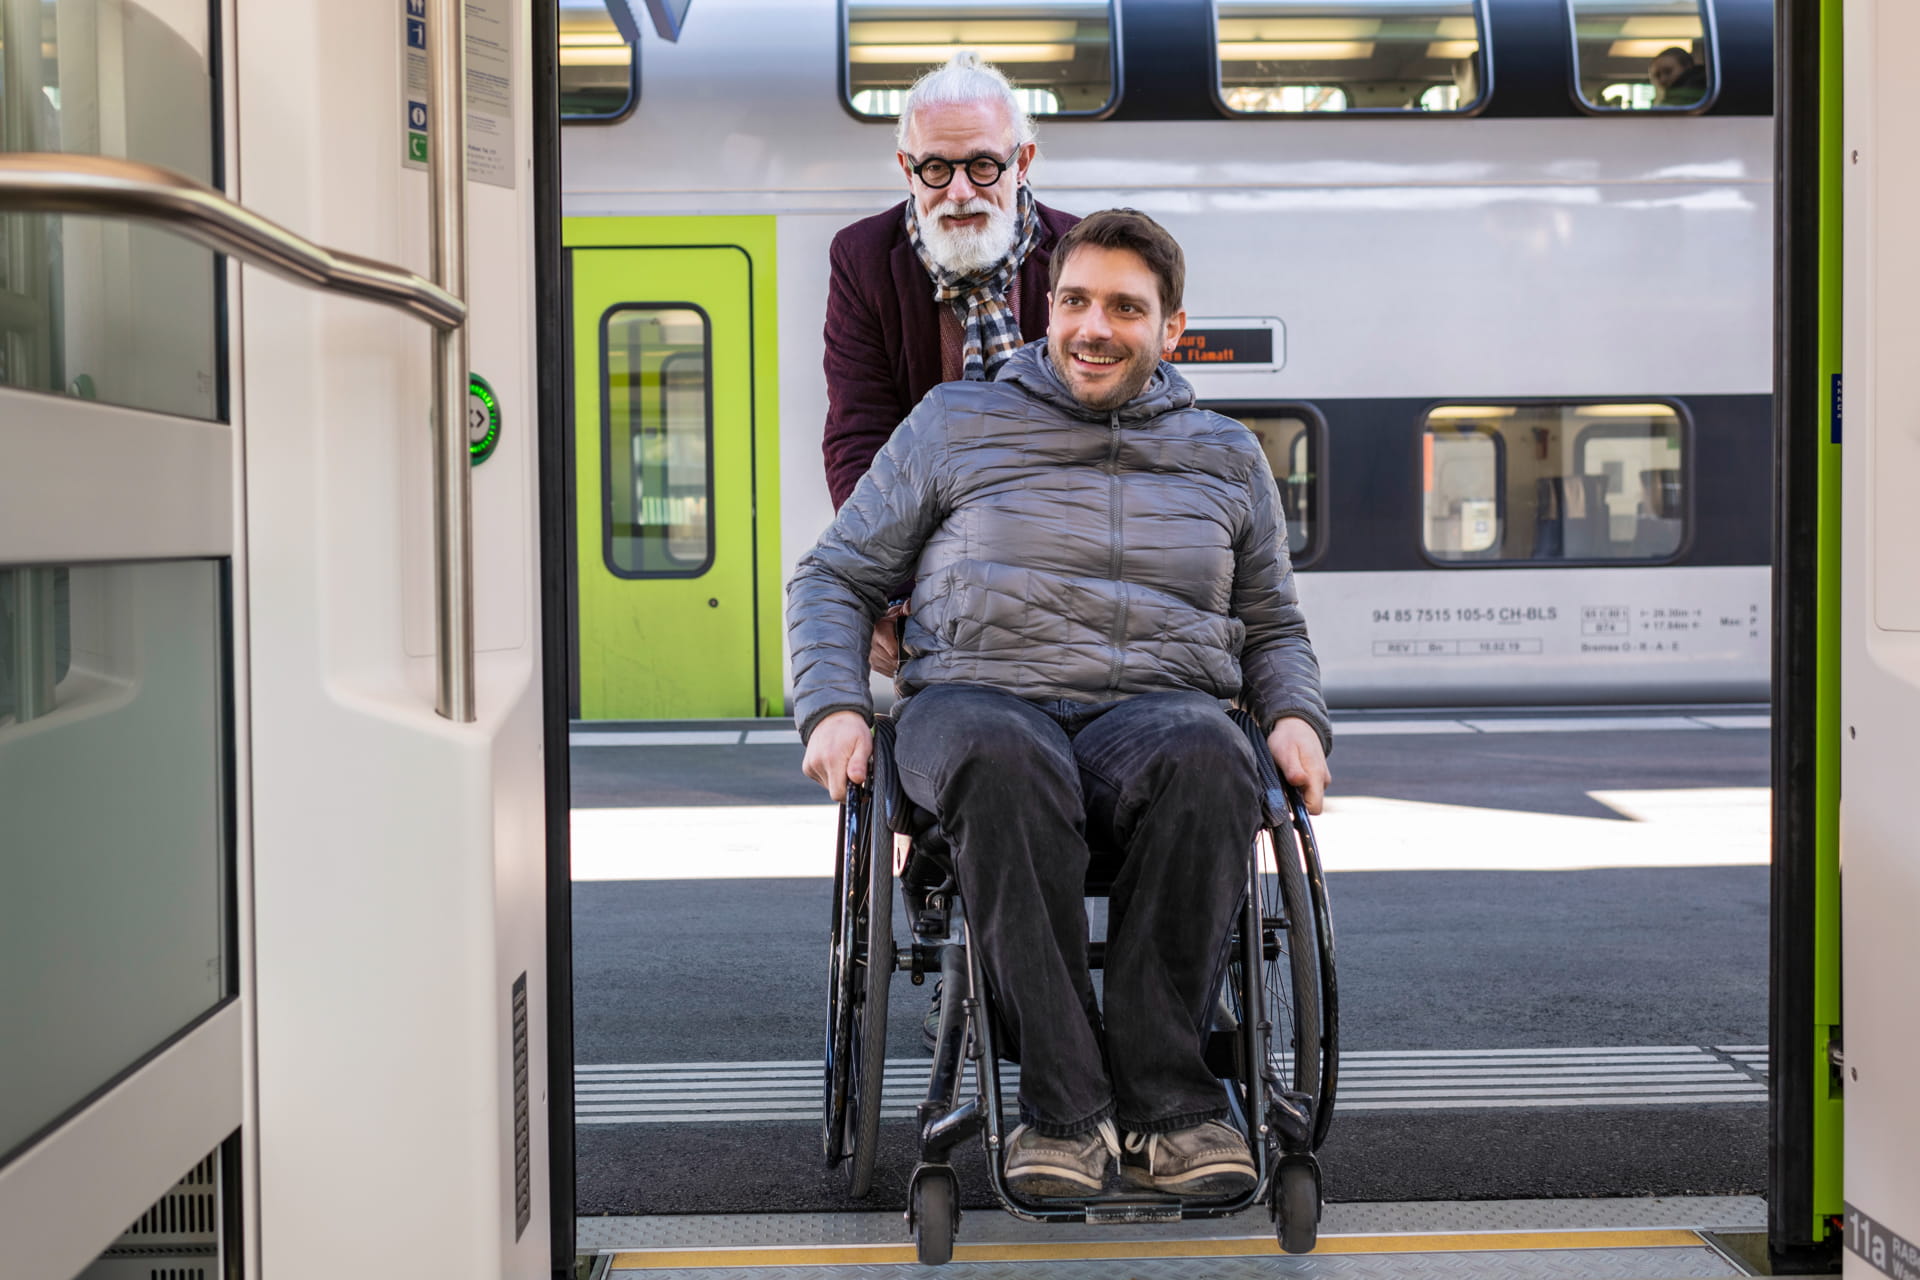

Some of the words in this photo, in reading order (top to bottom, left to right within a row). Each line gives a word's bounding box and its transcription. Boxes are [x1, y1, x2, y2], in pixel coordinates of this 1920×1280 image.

[1161, 351, 1182, 361] ern
[1372, 609, 1390, 623] 94
[1395, 608, 1412, 622] 85
[1416, 608, 1451, 622] 7515
[1456, 607, 1495, 621] 105-5
[1499, 606, 1558, 622] CH-BLS
[1849, 1212, 1887, 1270] 11a
